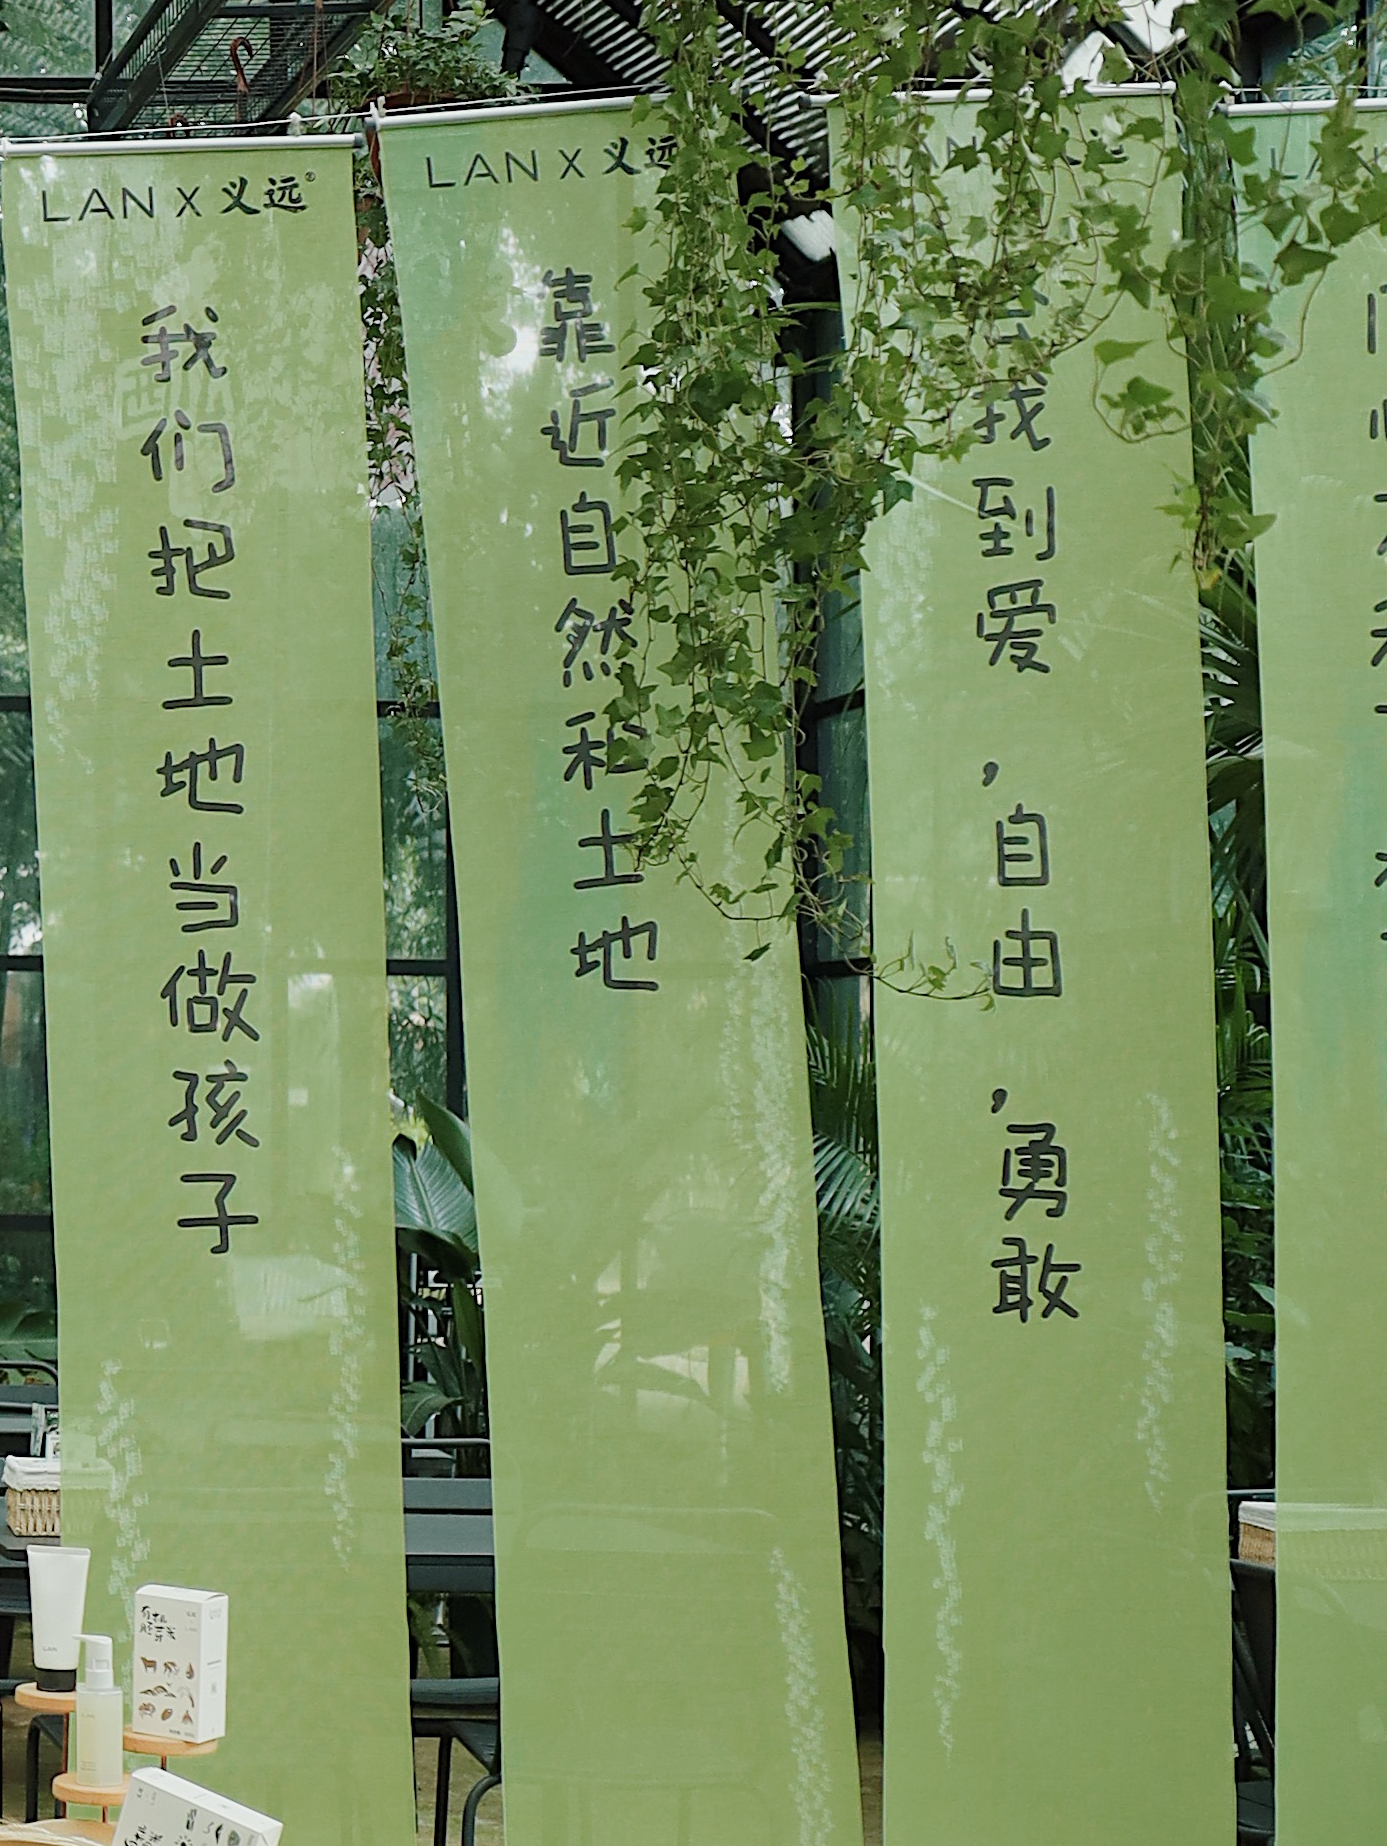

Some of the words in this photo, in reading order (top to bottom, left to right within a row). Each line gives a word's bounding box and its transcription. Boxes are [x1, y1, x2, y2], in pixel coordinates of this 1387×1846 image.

[425, 149, 539, 188] LAN
[41, 186, 155, 223] LAN
[140, 305, 261, 1255] 我们把土地当做孩子
